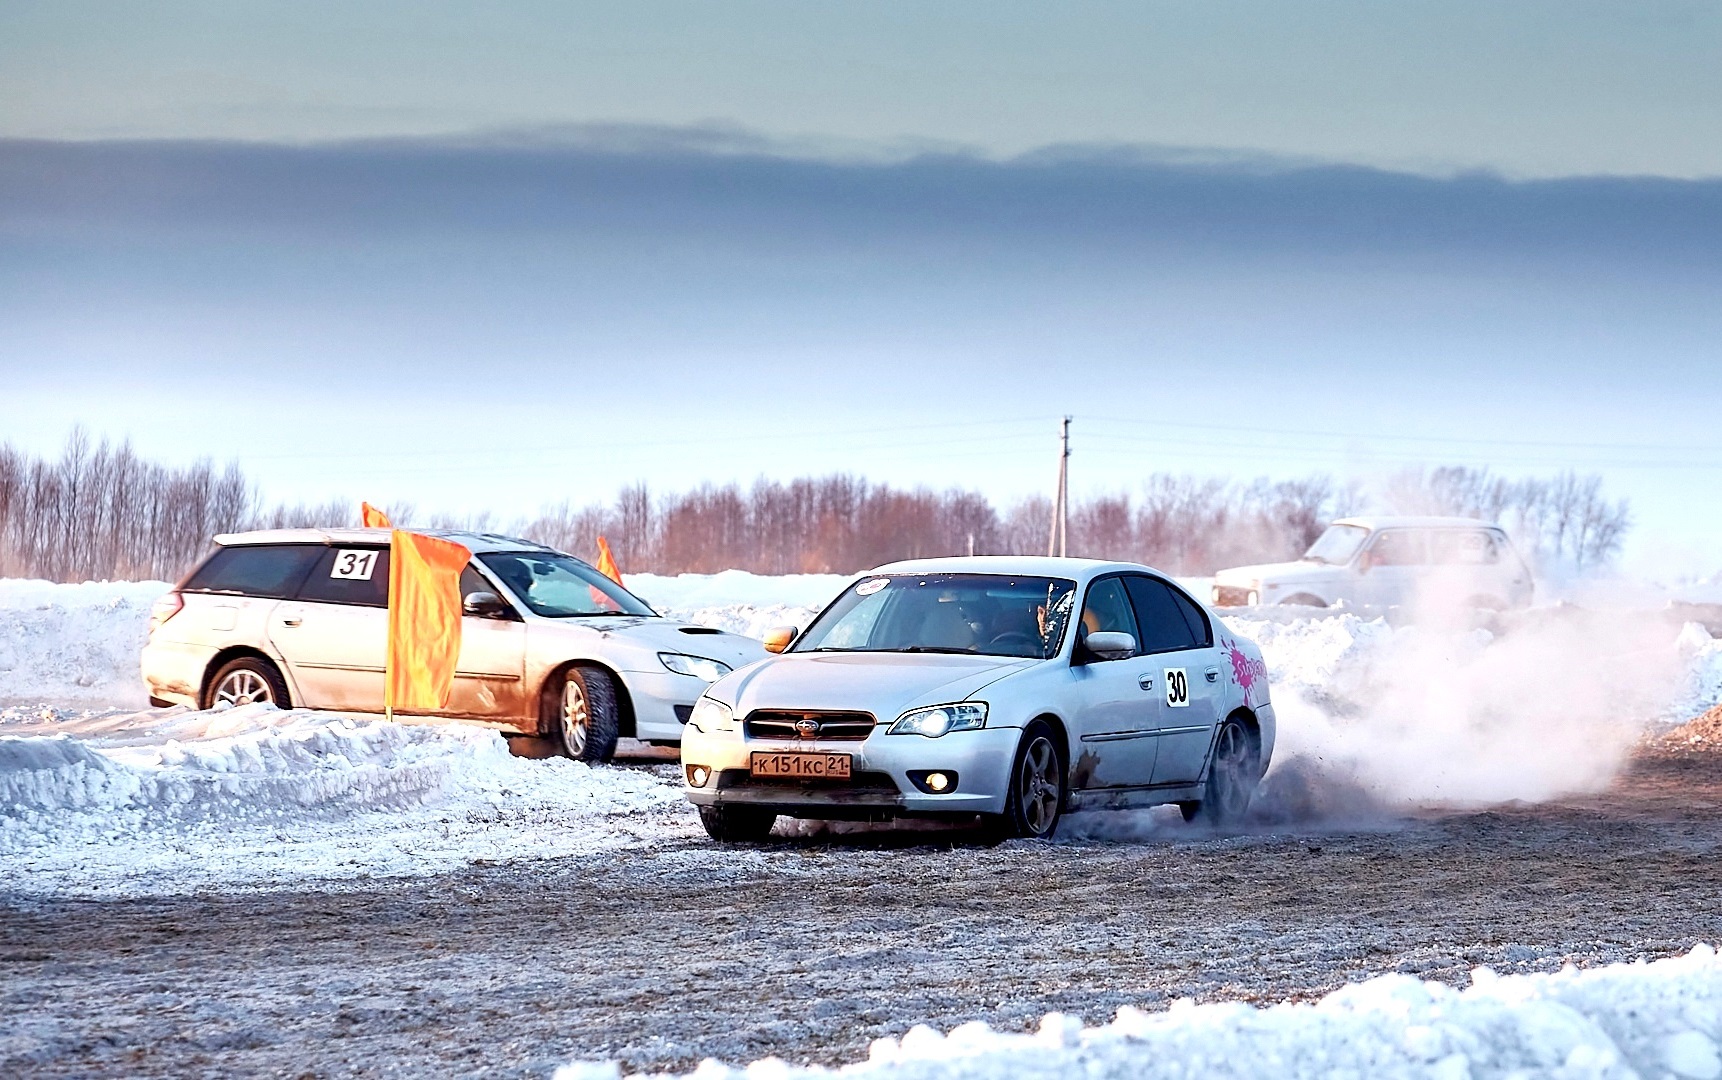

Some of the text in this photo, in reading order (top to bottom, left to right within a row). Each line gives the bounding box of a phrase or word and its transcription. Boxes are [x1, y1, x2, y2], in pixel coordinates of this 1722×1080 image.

[339, 553, 372, 576] 31
[1167, 671, 1187, 703] 30
[828, 757, 845, 771] 21
